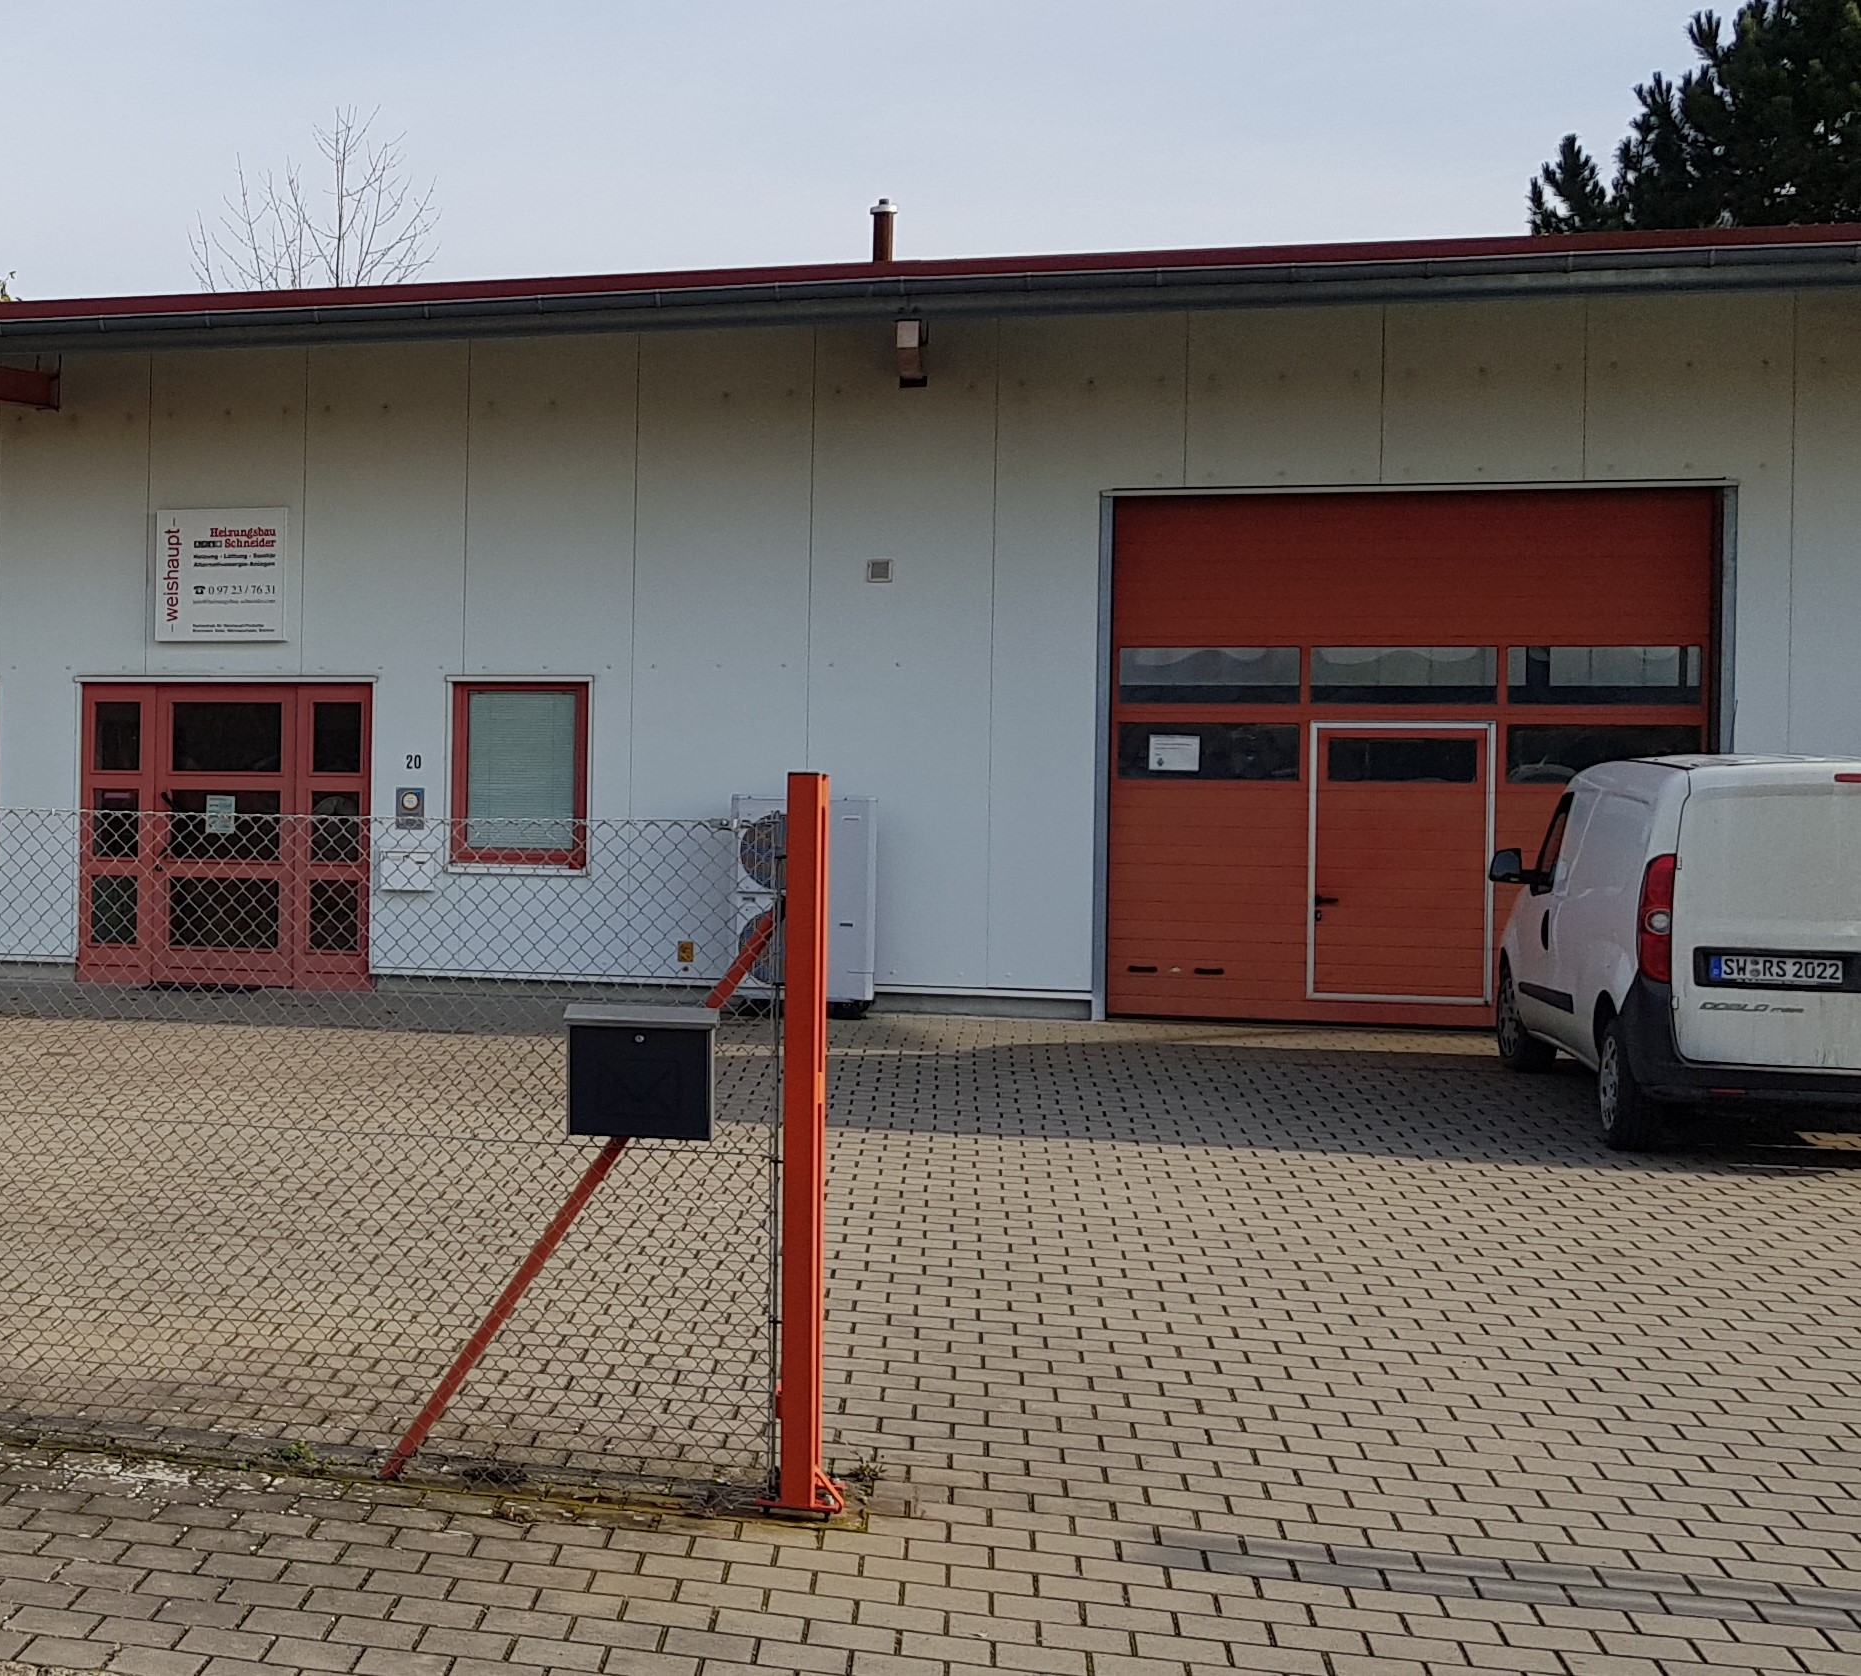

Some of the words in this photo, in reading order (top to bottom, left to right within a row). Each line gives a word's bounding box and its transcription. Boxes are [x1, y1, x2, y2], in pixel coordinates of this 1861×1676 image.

[209, 527, 277, 539] Heizungsbau
[224, 538, 277, 549] Schneider
[208, 585, 215, 595] 0
[216, 585, 229, 595] 97
[250, 585, 263, 595] 76
[264, 584, 276, 595] 31
[406, 754, 422, 769] 20
[1762, 959, 1787, 978] RS
[1792, 961, 1841, 980] 2022
